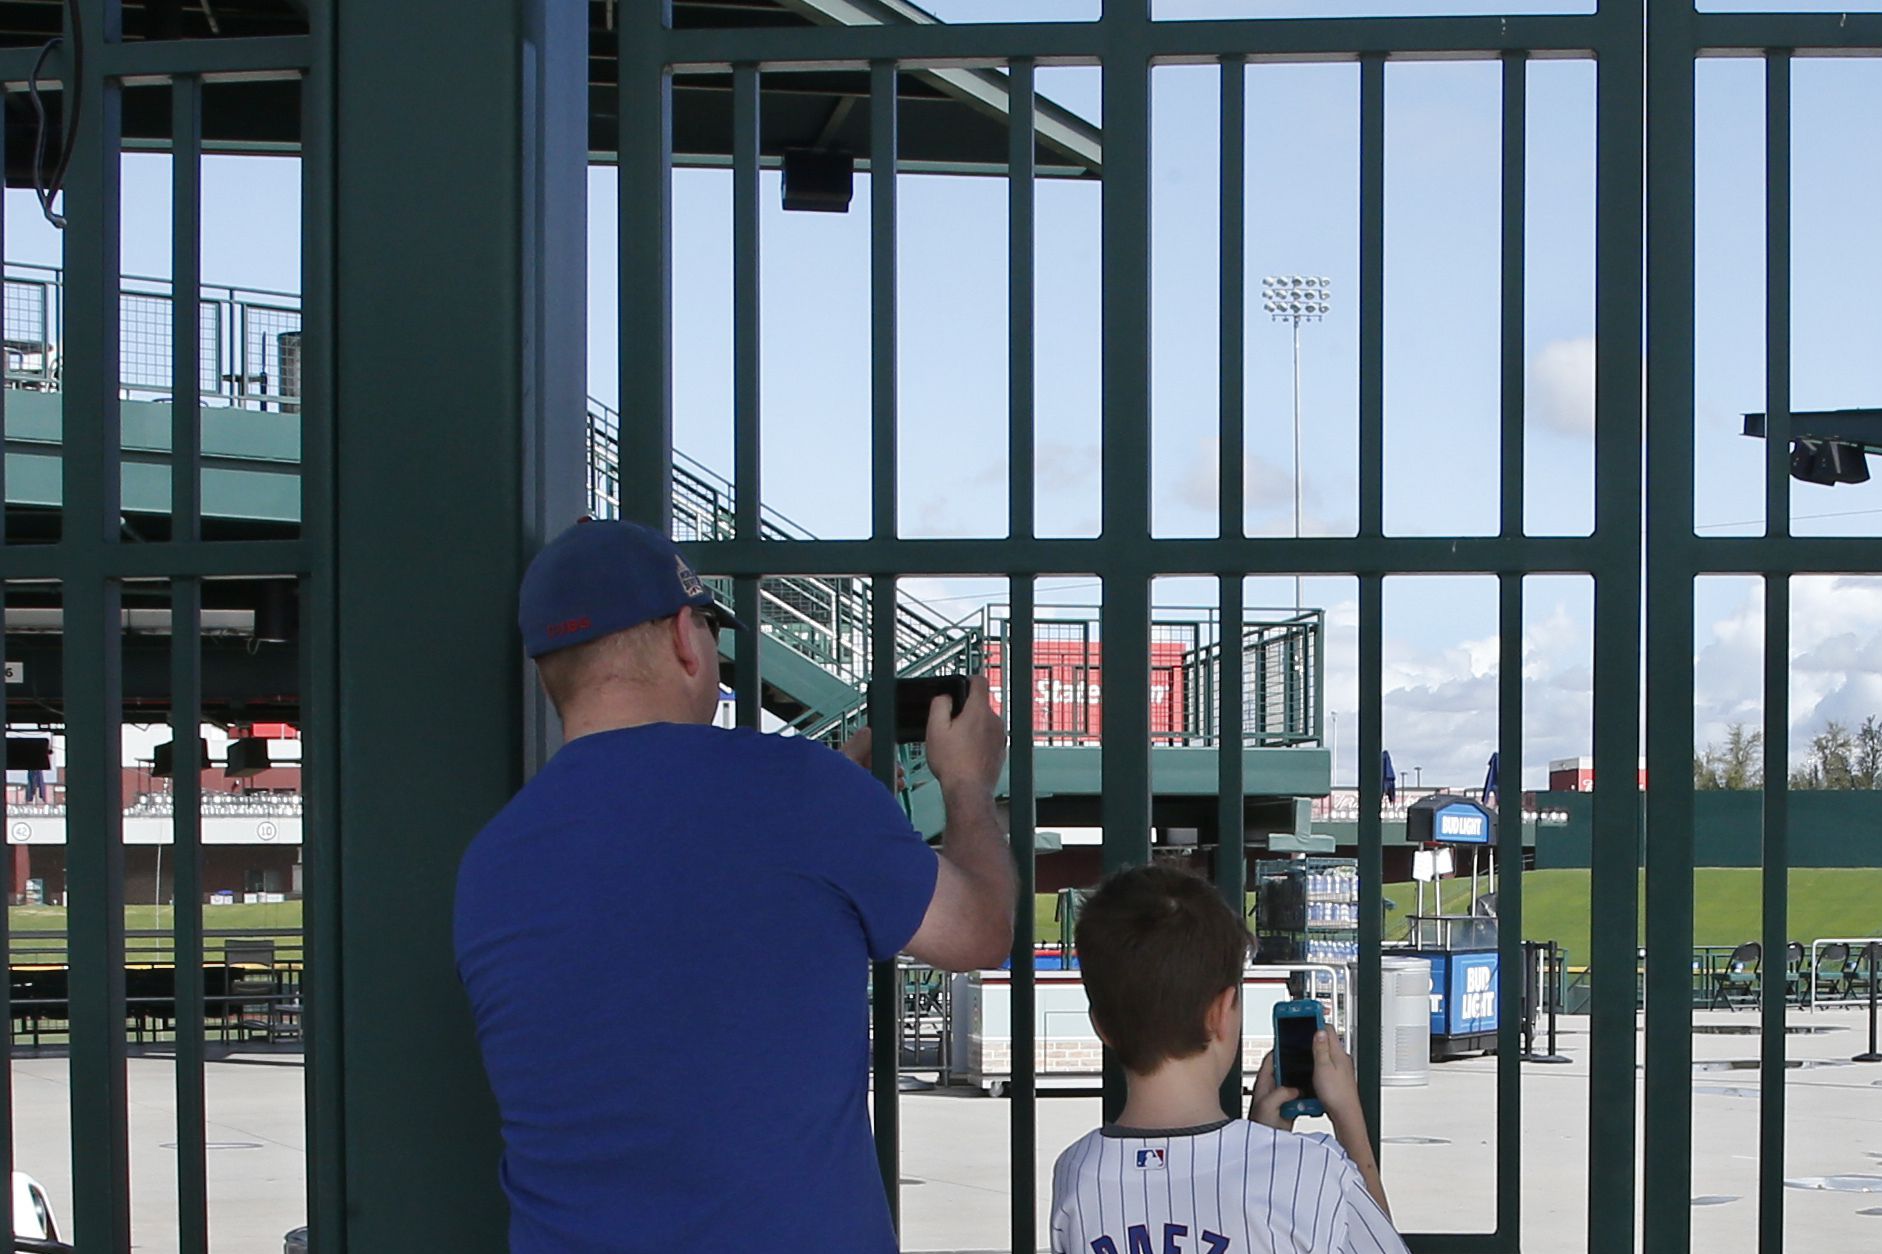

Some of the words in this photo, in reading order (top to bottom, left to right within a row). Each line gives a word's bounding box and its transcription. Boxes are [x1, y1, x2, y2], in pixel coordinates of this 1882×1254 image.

[261, 826, 273, 836] 10
[1442, 815, 1459, 834] BUD
[1460, 817, 1482, 836] LIGHT
[1466, 966, 1491, 993] BUD
